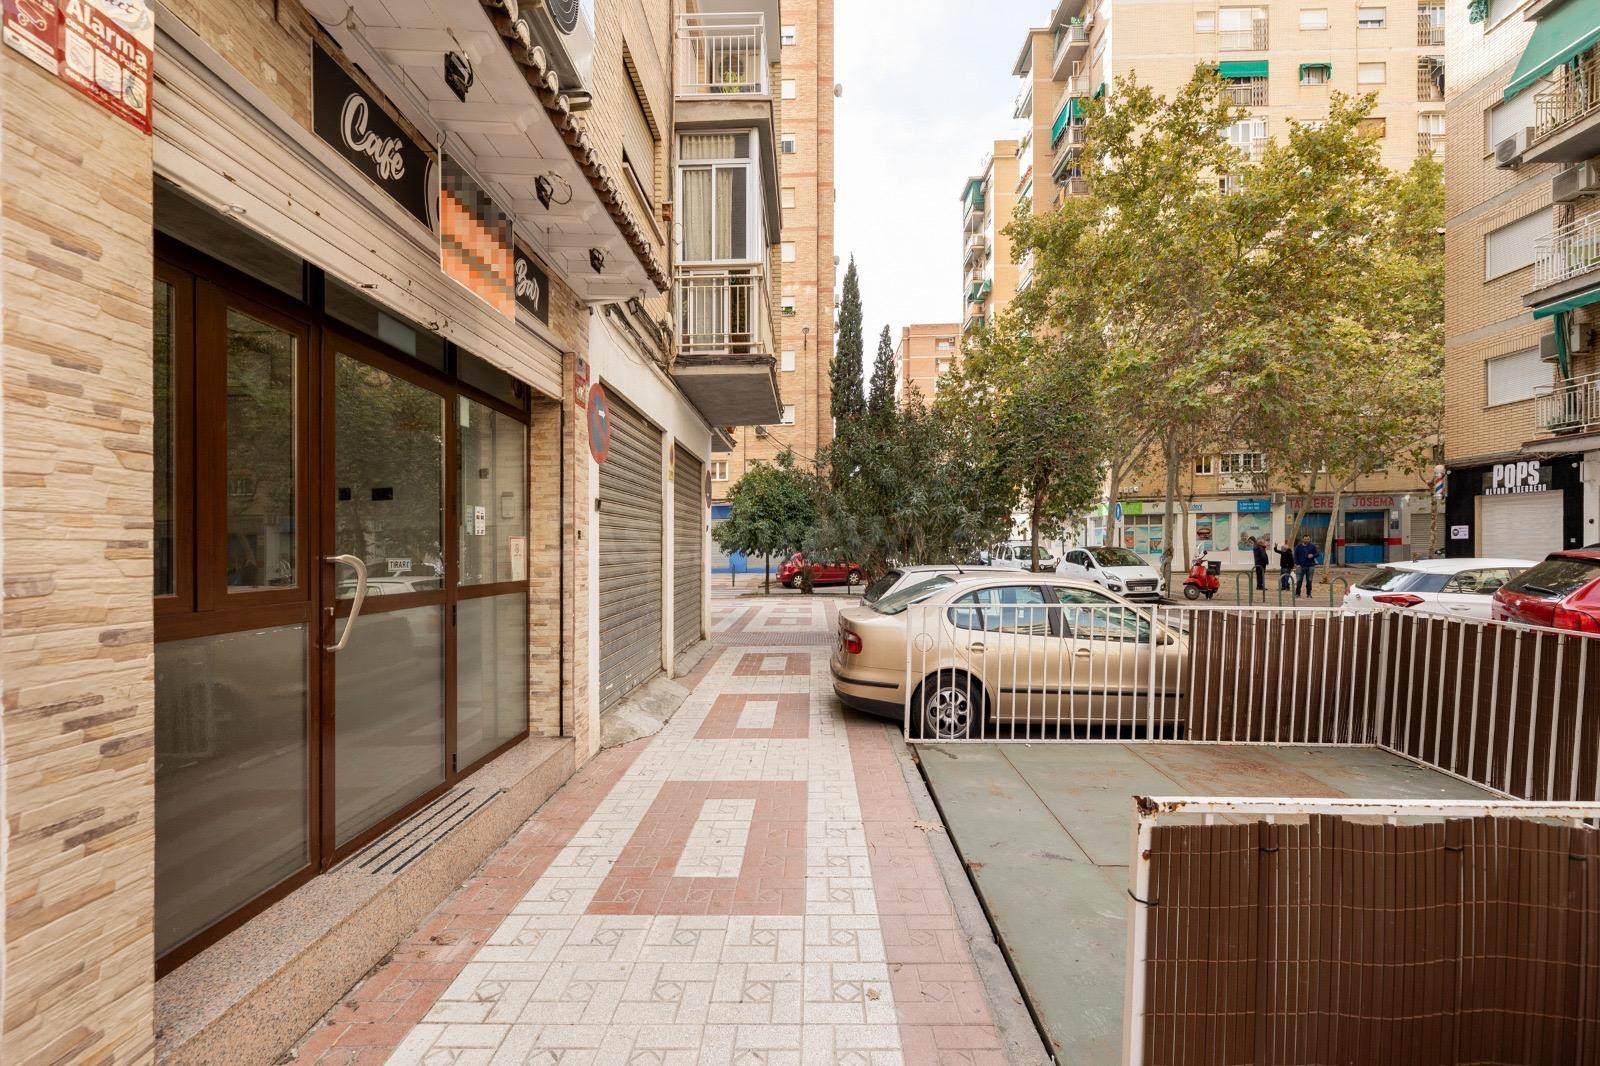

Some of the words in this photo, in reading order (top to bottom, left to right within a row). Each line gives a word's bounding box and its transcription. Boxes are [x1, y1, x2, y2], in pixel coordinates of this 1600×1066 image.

[65, 0, 147, 69] Alarma
[341, 92, 406, 181] Café
[515, 258, 540, 311] Bar
[1492, 460, 1540, 488] POPS
[1352, 496, 1395, 507] JOSEMA
